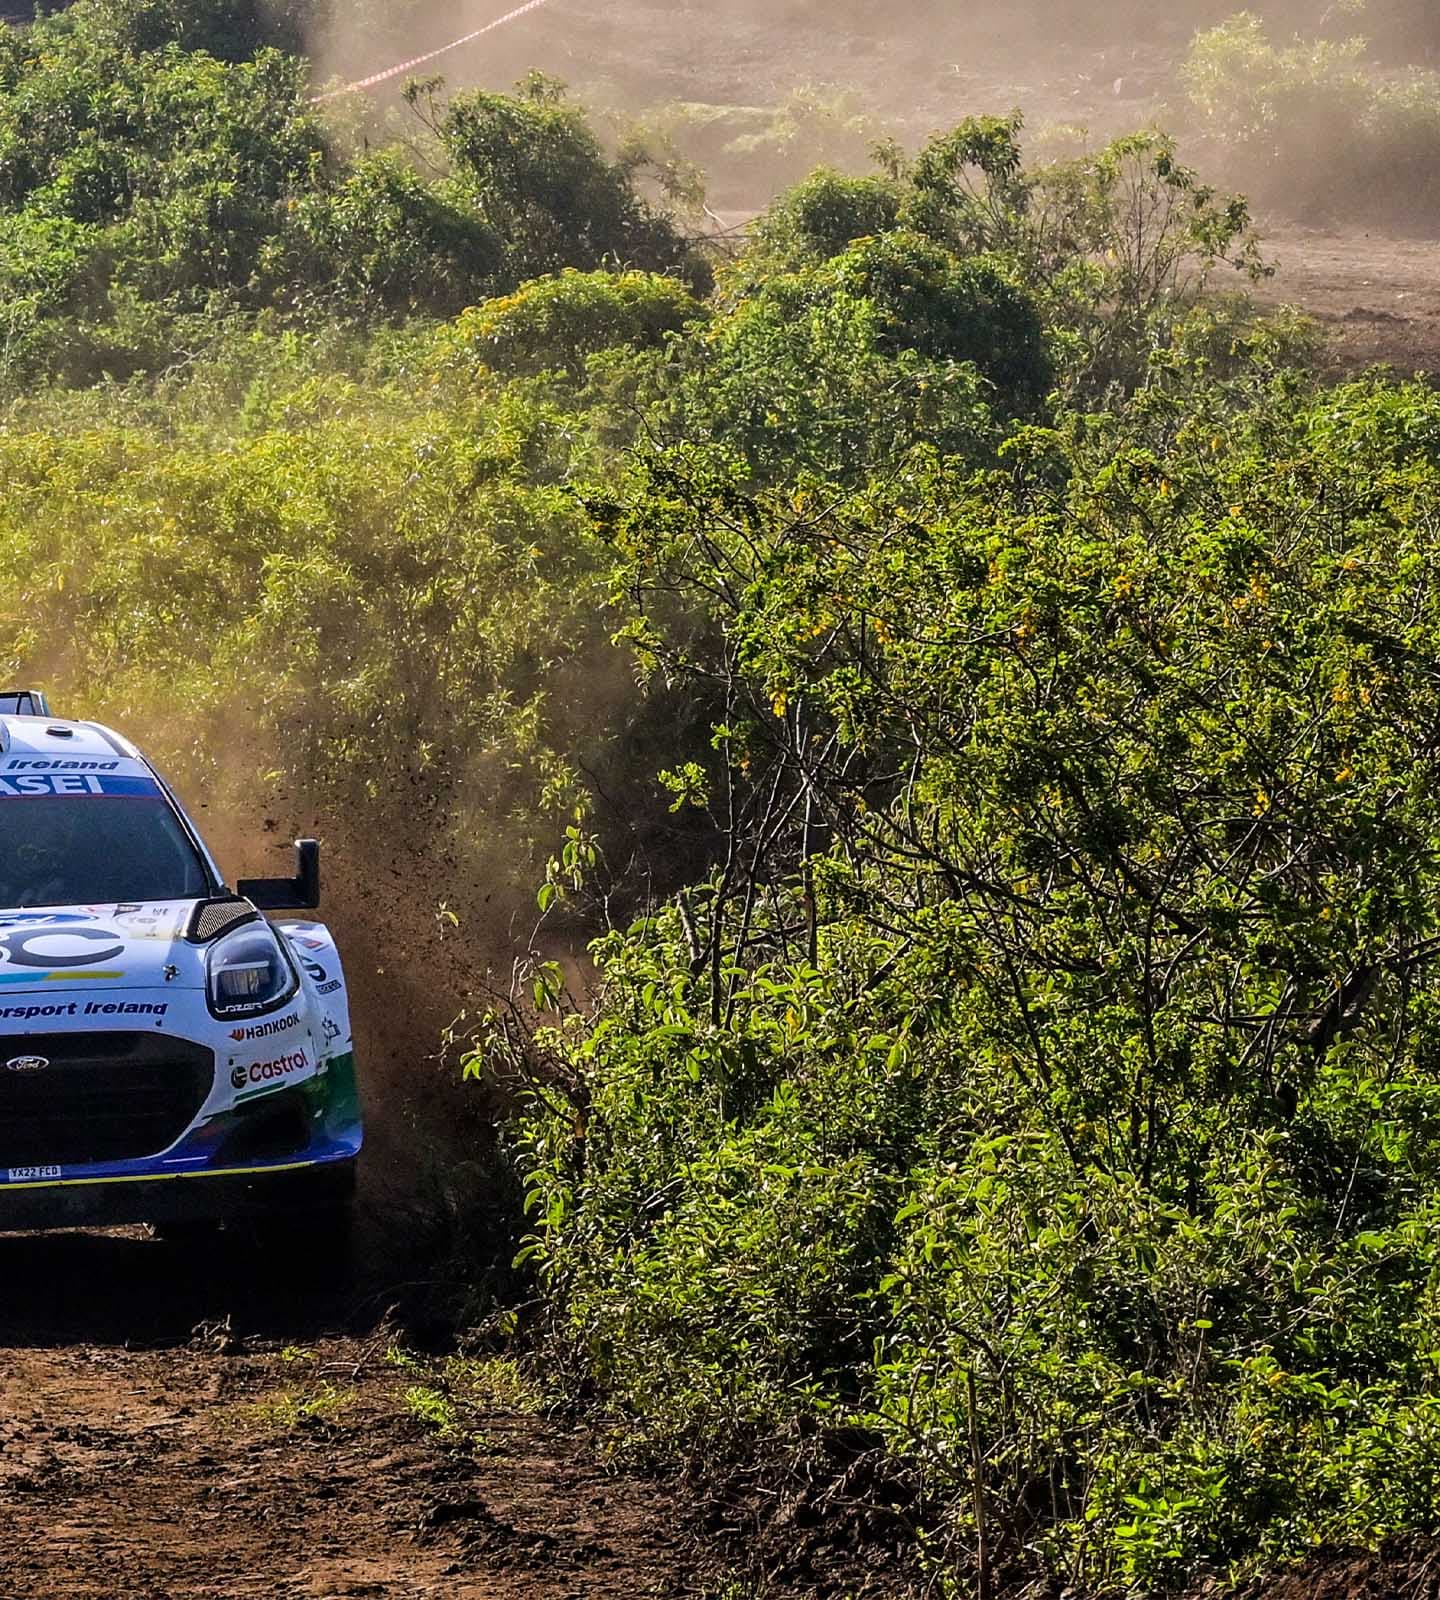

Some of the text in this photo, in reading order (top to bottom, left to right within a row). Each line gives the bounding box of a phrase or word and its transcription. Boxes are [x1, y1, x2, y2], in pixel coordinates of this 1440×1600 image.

[5, 758, 120, 771] Ireland
[83, 1001, 168, 1016] Ireland
[249, 1047, 308, 1082] Castrol
